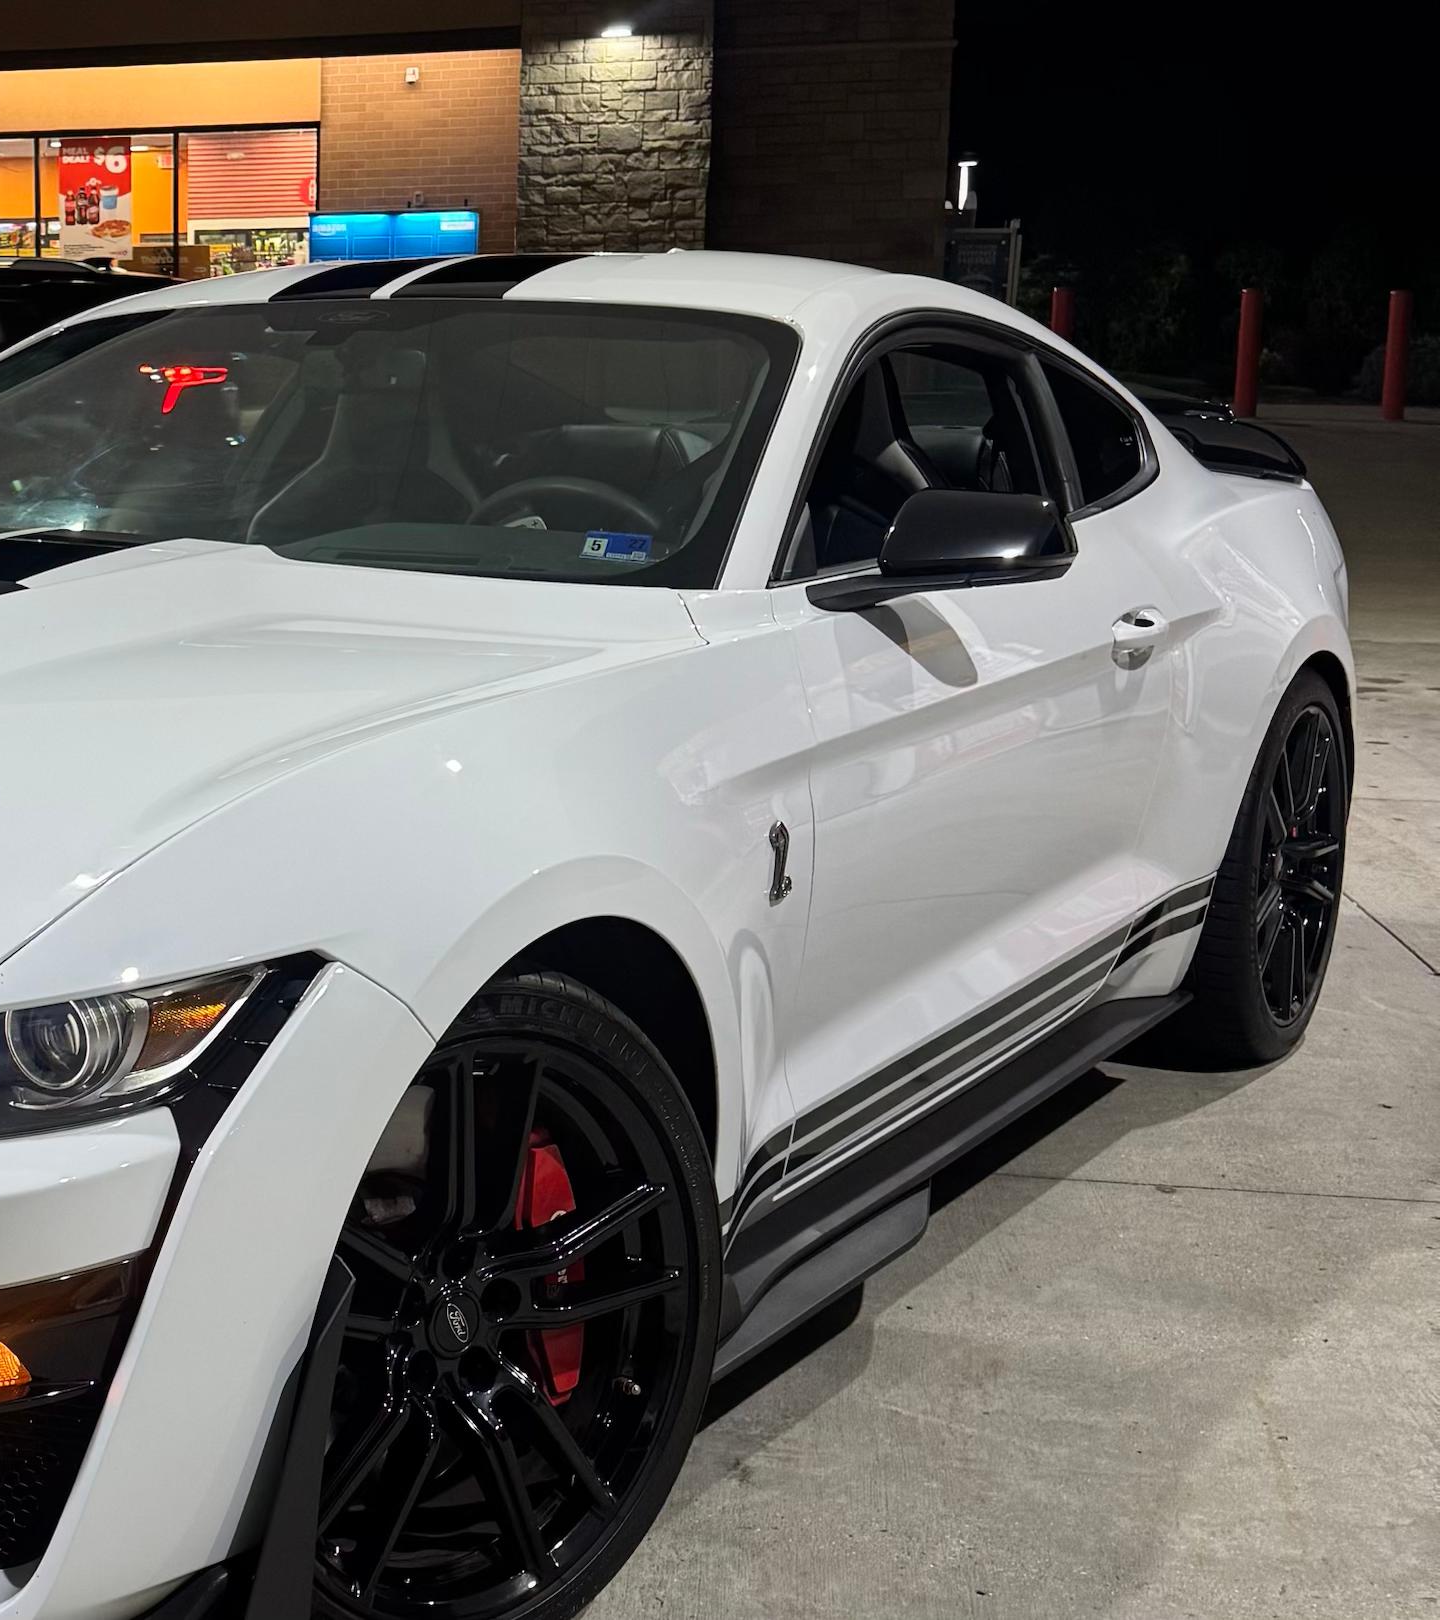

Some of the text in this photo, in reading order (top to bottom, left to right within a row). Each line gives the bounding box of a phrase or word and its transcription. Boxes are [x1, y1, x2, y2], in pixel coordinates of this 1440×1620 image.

[94, 146, 127, 174] $6
[591, 540, 602, 551] 5
[448, 1308, 468, 1338] Ford
